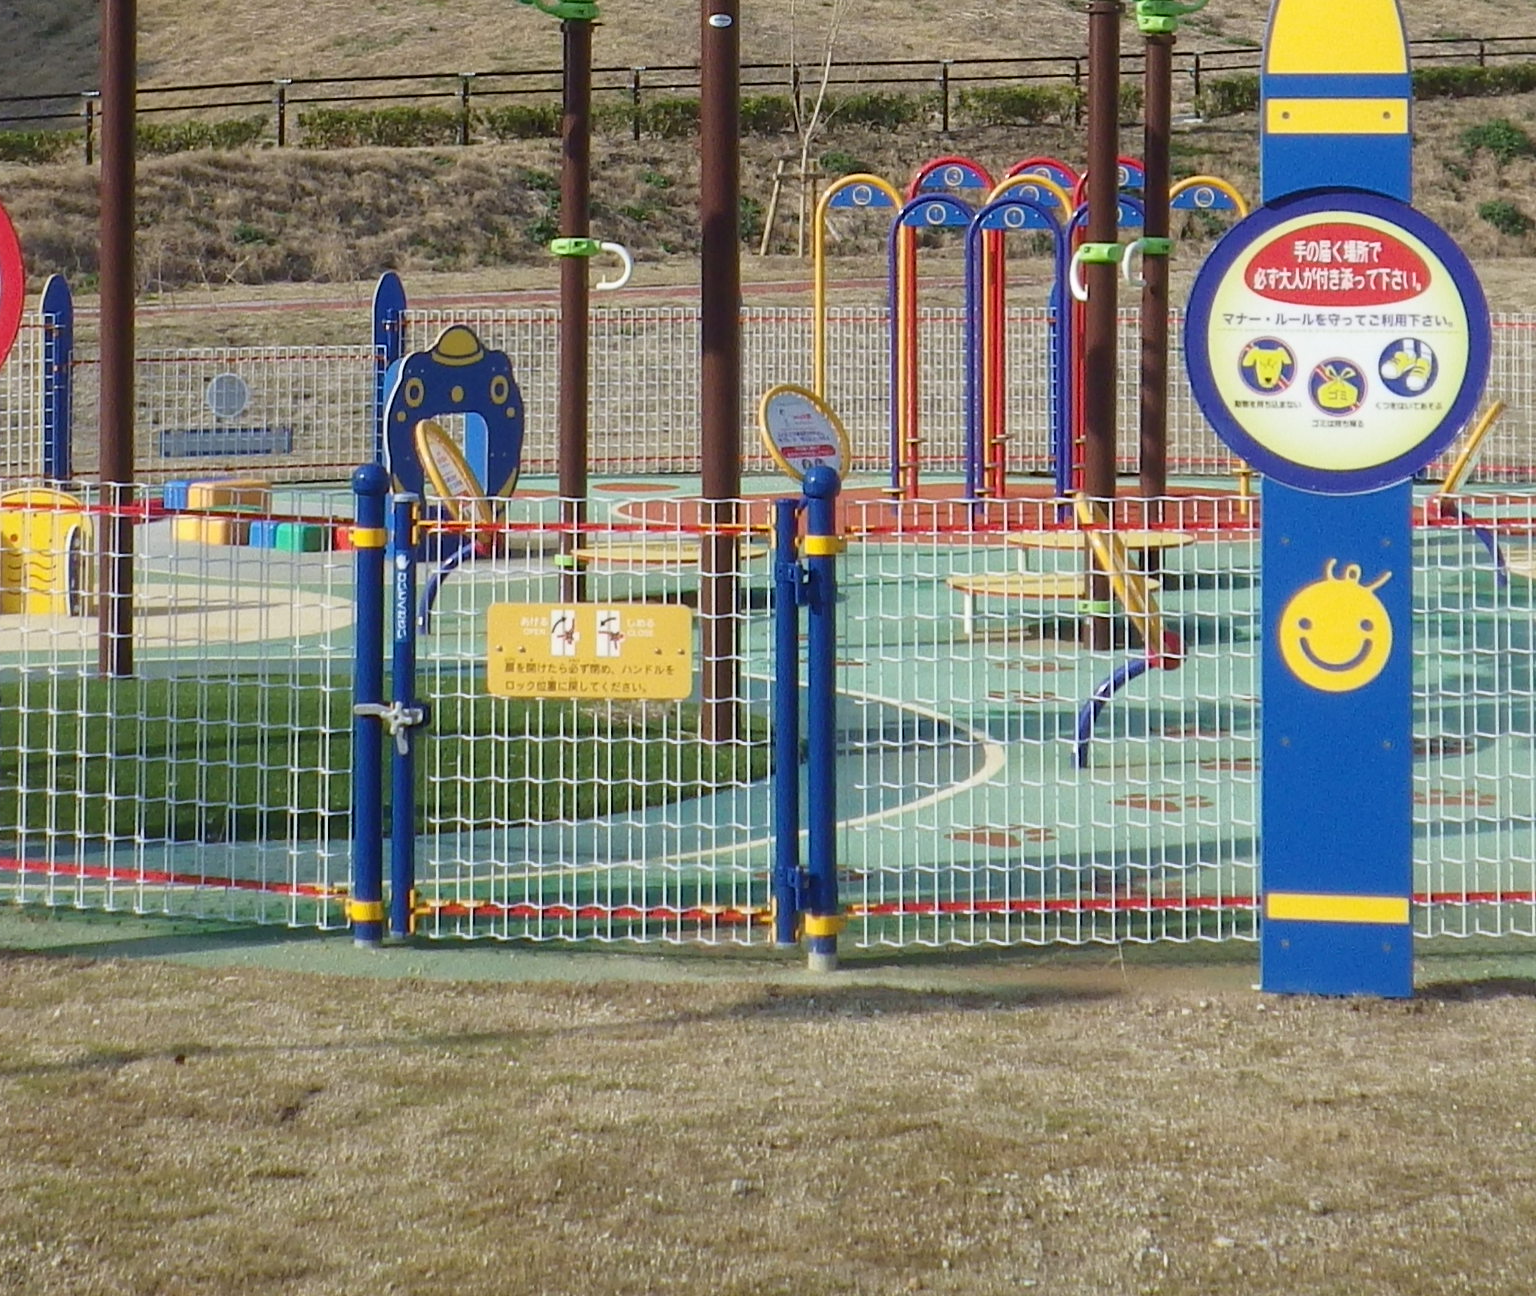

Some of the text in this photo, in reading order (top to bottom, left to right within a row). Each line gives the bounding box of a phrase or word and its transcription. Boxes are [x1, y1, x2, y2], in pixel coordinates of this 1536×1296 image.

[1293, 240, 1382, 263] 手の届く場所で
[1253, 267, 1422, 292] 必ず大人が付き添って下さい。
[1222, 312, 1455, 328] マナー・ルールを守ってご利用下さい。
[1328, 389, 1349, 401] ゴミ
